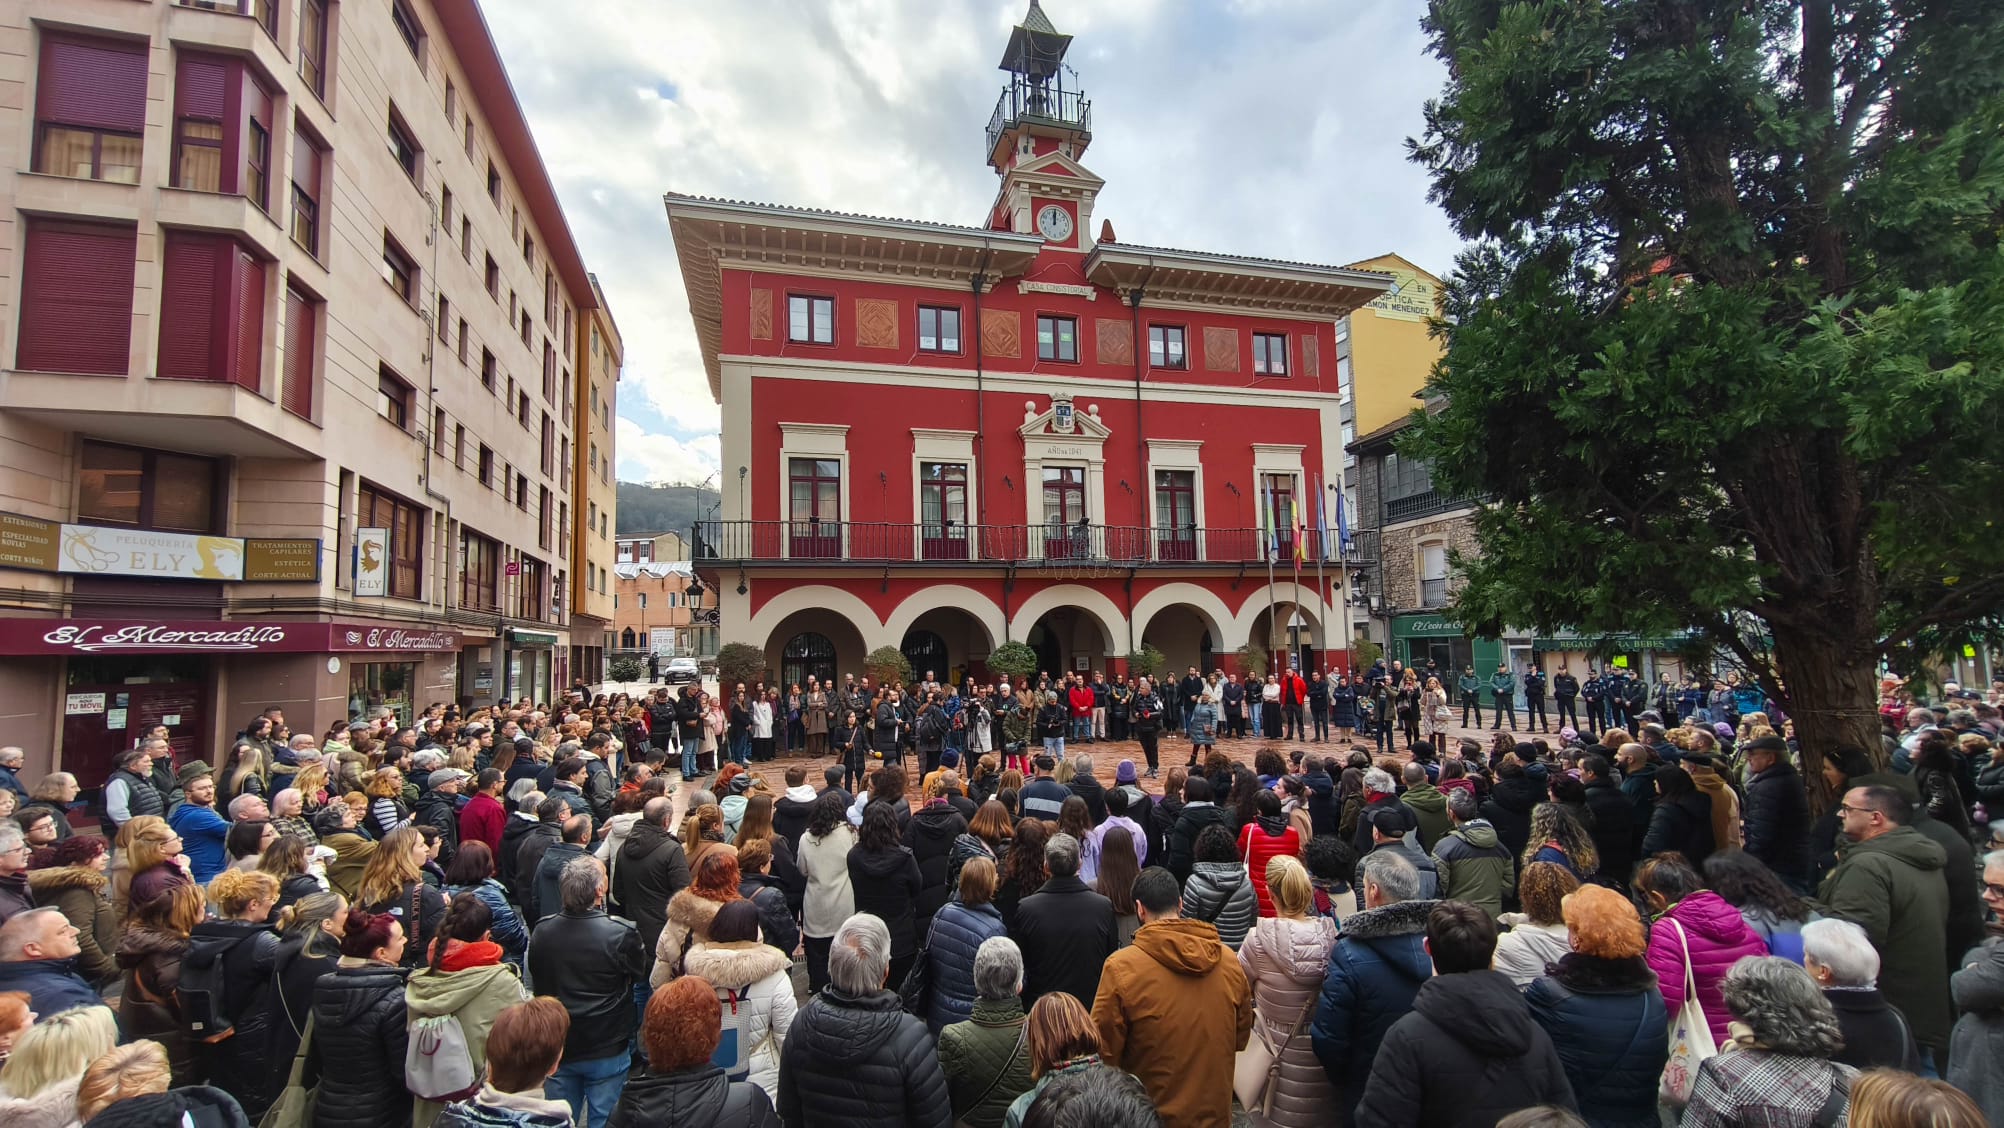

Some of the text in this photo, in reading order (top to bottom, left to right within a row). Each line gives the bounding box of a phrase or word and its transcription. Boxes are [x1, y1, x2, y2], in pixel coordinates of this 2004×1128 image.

[1417, 285, 1426, 293] EN
[1365, 300, 1388, 309] AMON
[129, 551, 187, 571] ELY
[359, 579, 382, 589] ELY
[43, 626, 285, 644] El Mercadillo
[367, 628, 444, 649] El Mercadillo
[1560, 641, 1597, 649] REGALO
